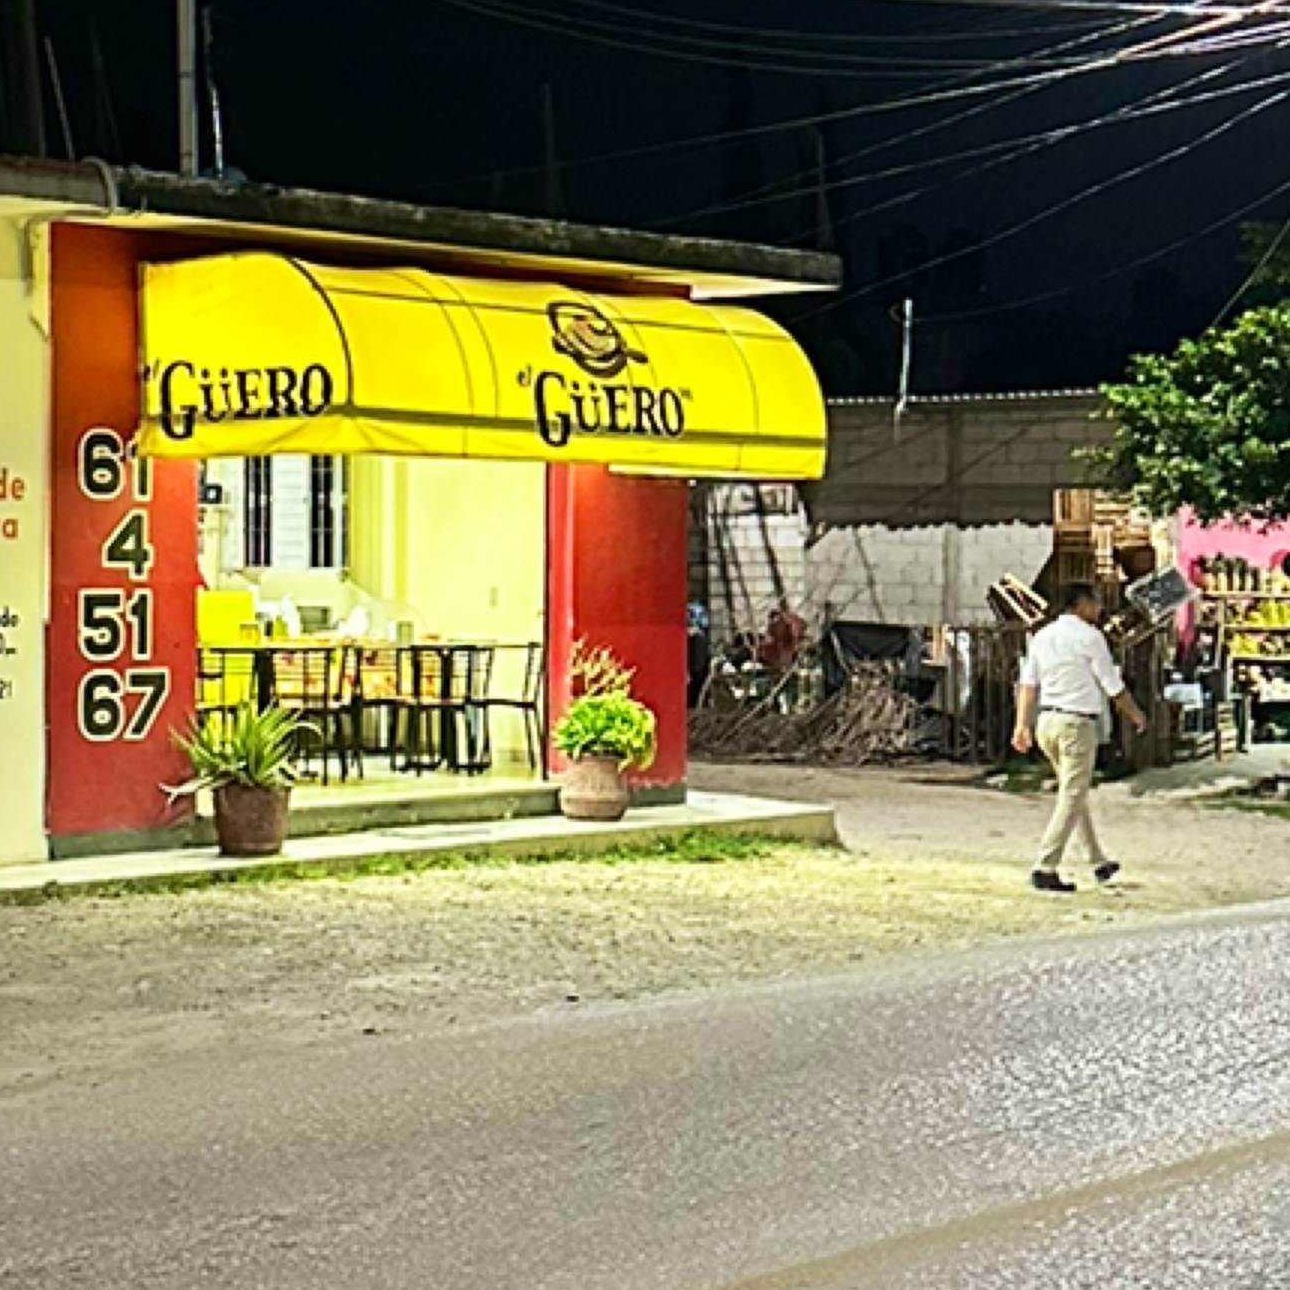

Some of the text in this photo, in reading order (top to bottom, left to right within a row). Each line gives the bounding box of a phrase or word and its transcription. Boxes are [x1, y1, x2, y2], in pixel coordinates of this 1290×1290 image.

[78, 428, 154, 501] 61
[101, 508, 154, 580] 4
[78, 587, 153, 661] 51
[78, 668, 170, 742] 67
